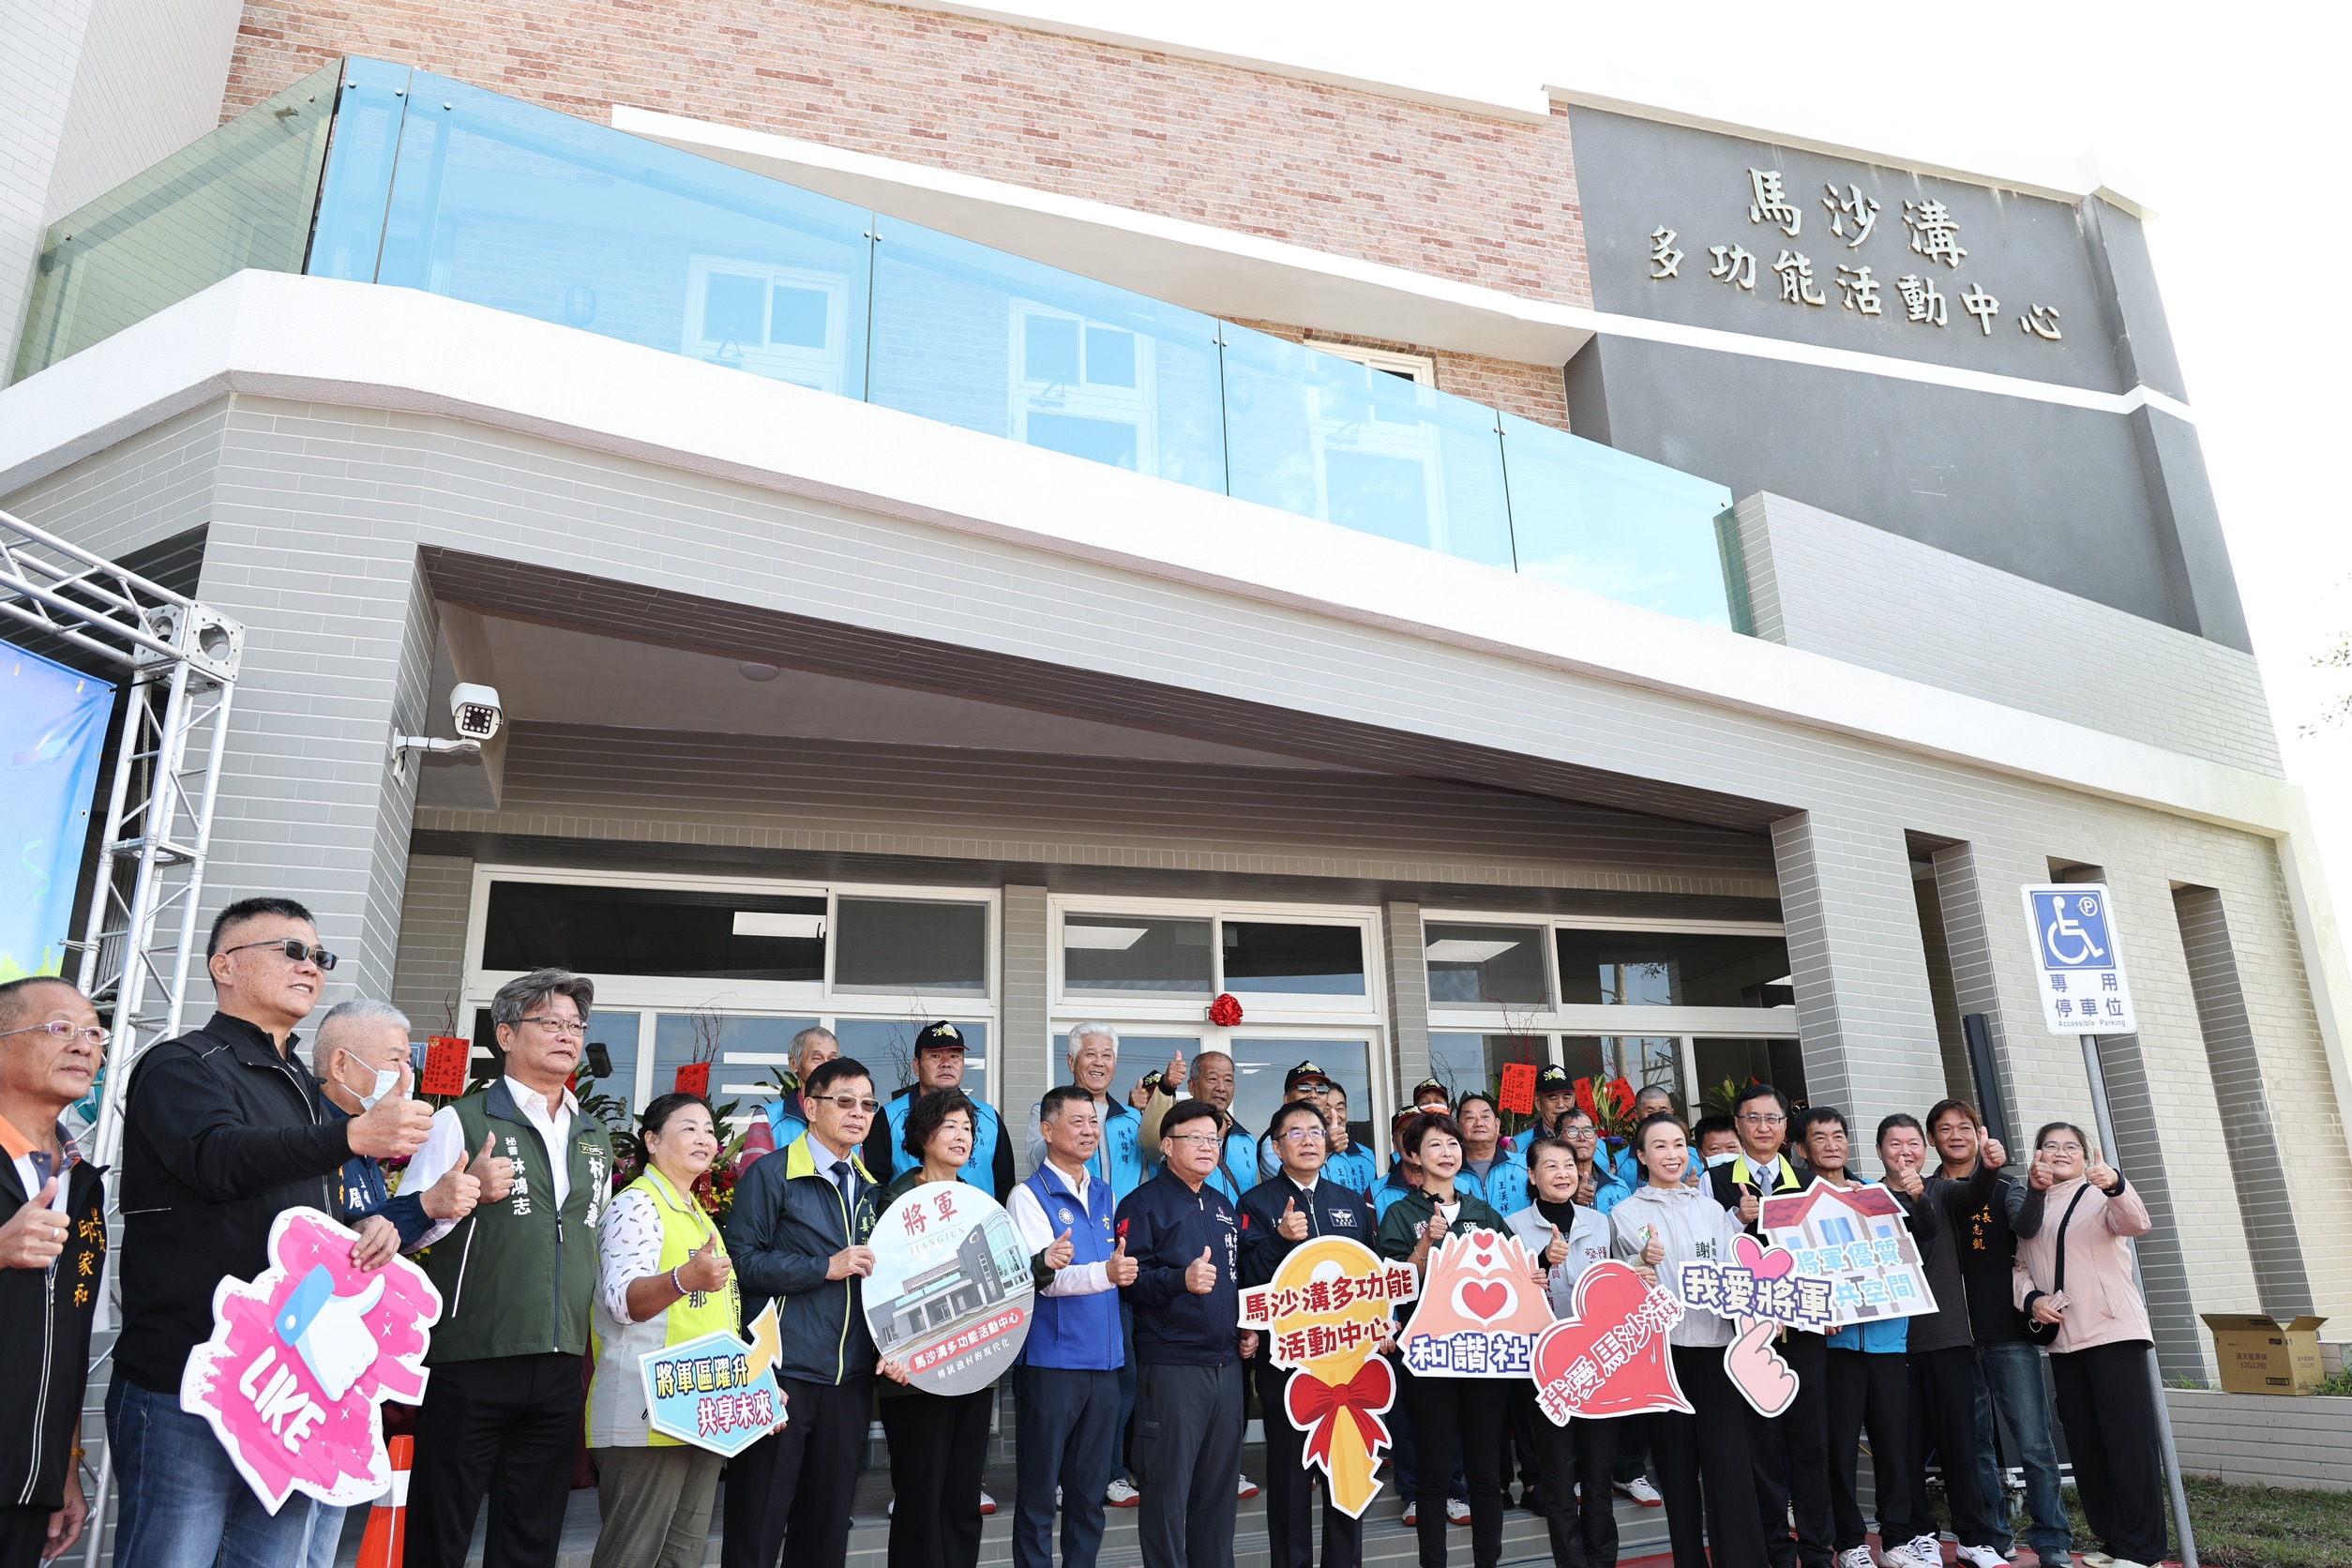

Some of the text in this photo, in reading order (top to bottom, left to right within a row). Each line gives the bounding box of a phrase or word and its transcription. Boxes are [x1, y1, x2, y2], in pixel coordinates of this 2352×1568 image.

[1748, 167, 1968, 268] 馬沙溝
[1651, 225, 2062, 340] 多功能活動中心
[2050, 973, 2118, 993] 專用
[2055, 998, 2124, 1018] 停車位
[2058, 1018, 2126, 1028] Accessible Parking
[505, 1137, 519, 1156] 秘書
[901, 1189, 958, 1237] 將軍
[74, 1219, 98, 1308] 邱家和
[910, 1226, 966, 1256] JIANGJUN
[1696, 1241, 1710, 1259] 謝
[1796, 1238, 1904, 1276] 將軍優質
[1245, 1267, 1413, 1322] 馬沙溝多功能
[1683, 1266, 1832, 1323] 我愛將軍
[913, 1311, 1020, 1370] 馬沙溝多功能活動中心
[937, 1338, 1011, 1380] 傳統漁村的現代化
[1277, 1317, 1391, 1362] 活動中心
[1409, 1332, 1539, 1373] 和諧社
[1539, 1287, 1684, 1425] 我愛馬沙溝
[655, 1353, 749, 1399] 將軍區躍升
[238, 1344, 327, 1455] LIKE
[697, 1389, 775, 1438] 共享未來
